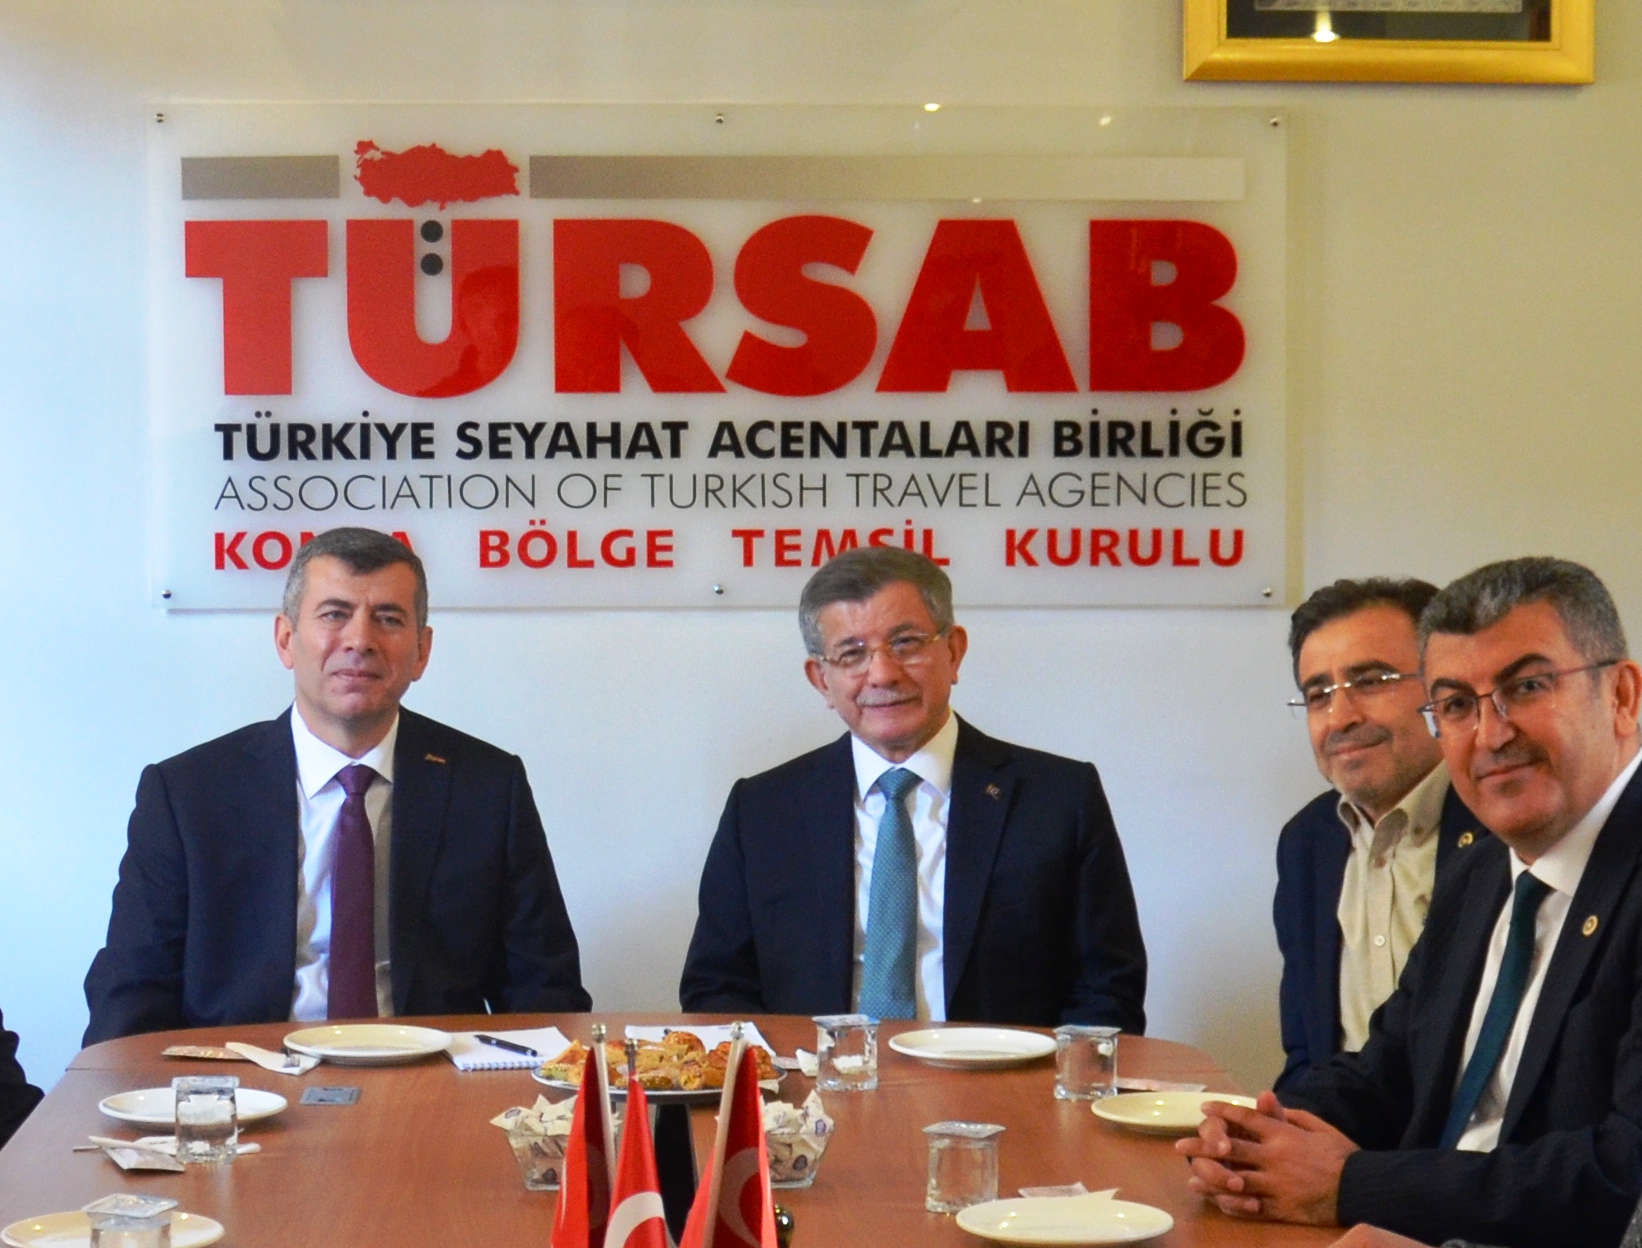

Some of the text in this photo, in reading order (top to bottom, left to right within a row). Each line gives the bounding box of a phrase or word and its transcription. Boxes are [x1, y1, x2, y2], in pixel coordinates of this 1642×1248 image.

[184, 215, 1248, 399] TÜRSAB
[214, 407, 1244, 462] TÜRKİYE SEYAHAT ACENTALARI BİRLİĞİ
[214, 470, 1248, 512] ASSOCIATION OF TURKISH TRAVEL AGENCIES
[478, 519, 676, 570] BÖLGE
[1004, 527, 1245, 568] KURULU
